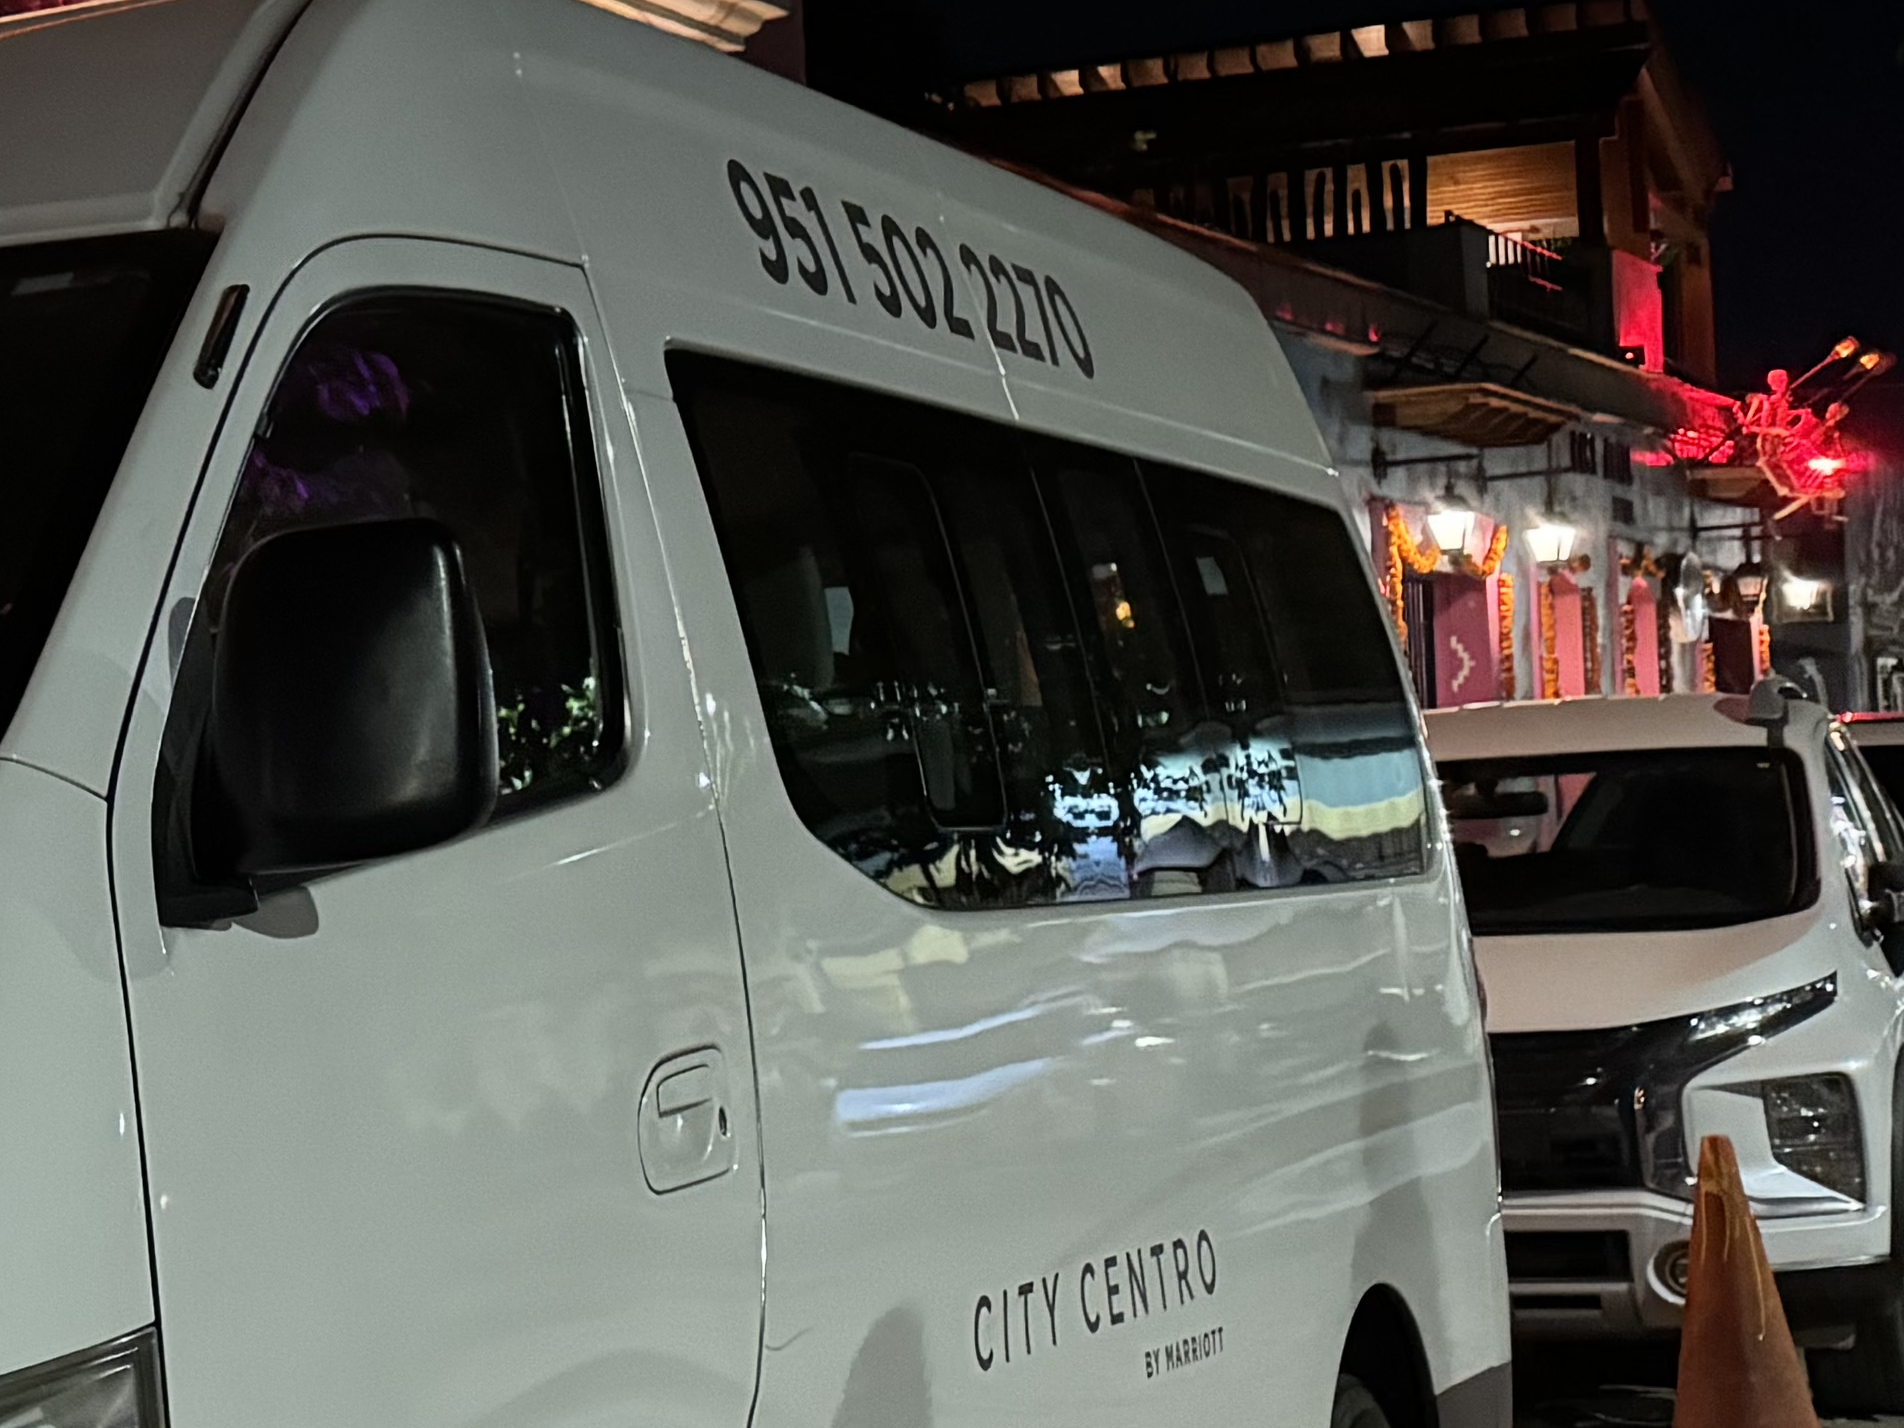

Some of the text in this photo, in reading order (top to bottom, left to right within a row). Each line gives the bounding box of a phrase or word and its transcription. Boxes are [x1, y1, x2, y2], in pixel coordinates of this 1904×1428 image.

[726, 159, 1095, 379] 951 502 2270
[974, 1229, 1216, 1372] CITY CENTRO
[1145, 1326, 1224, 1379] BY MARRIOTT
